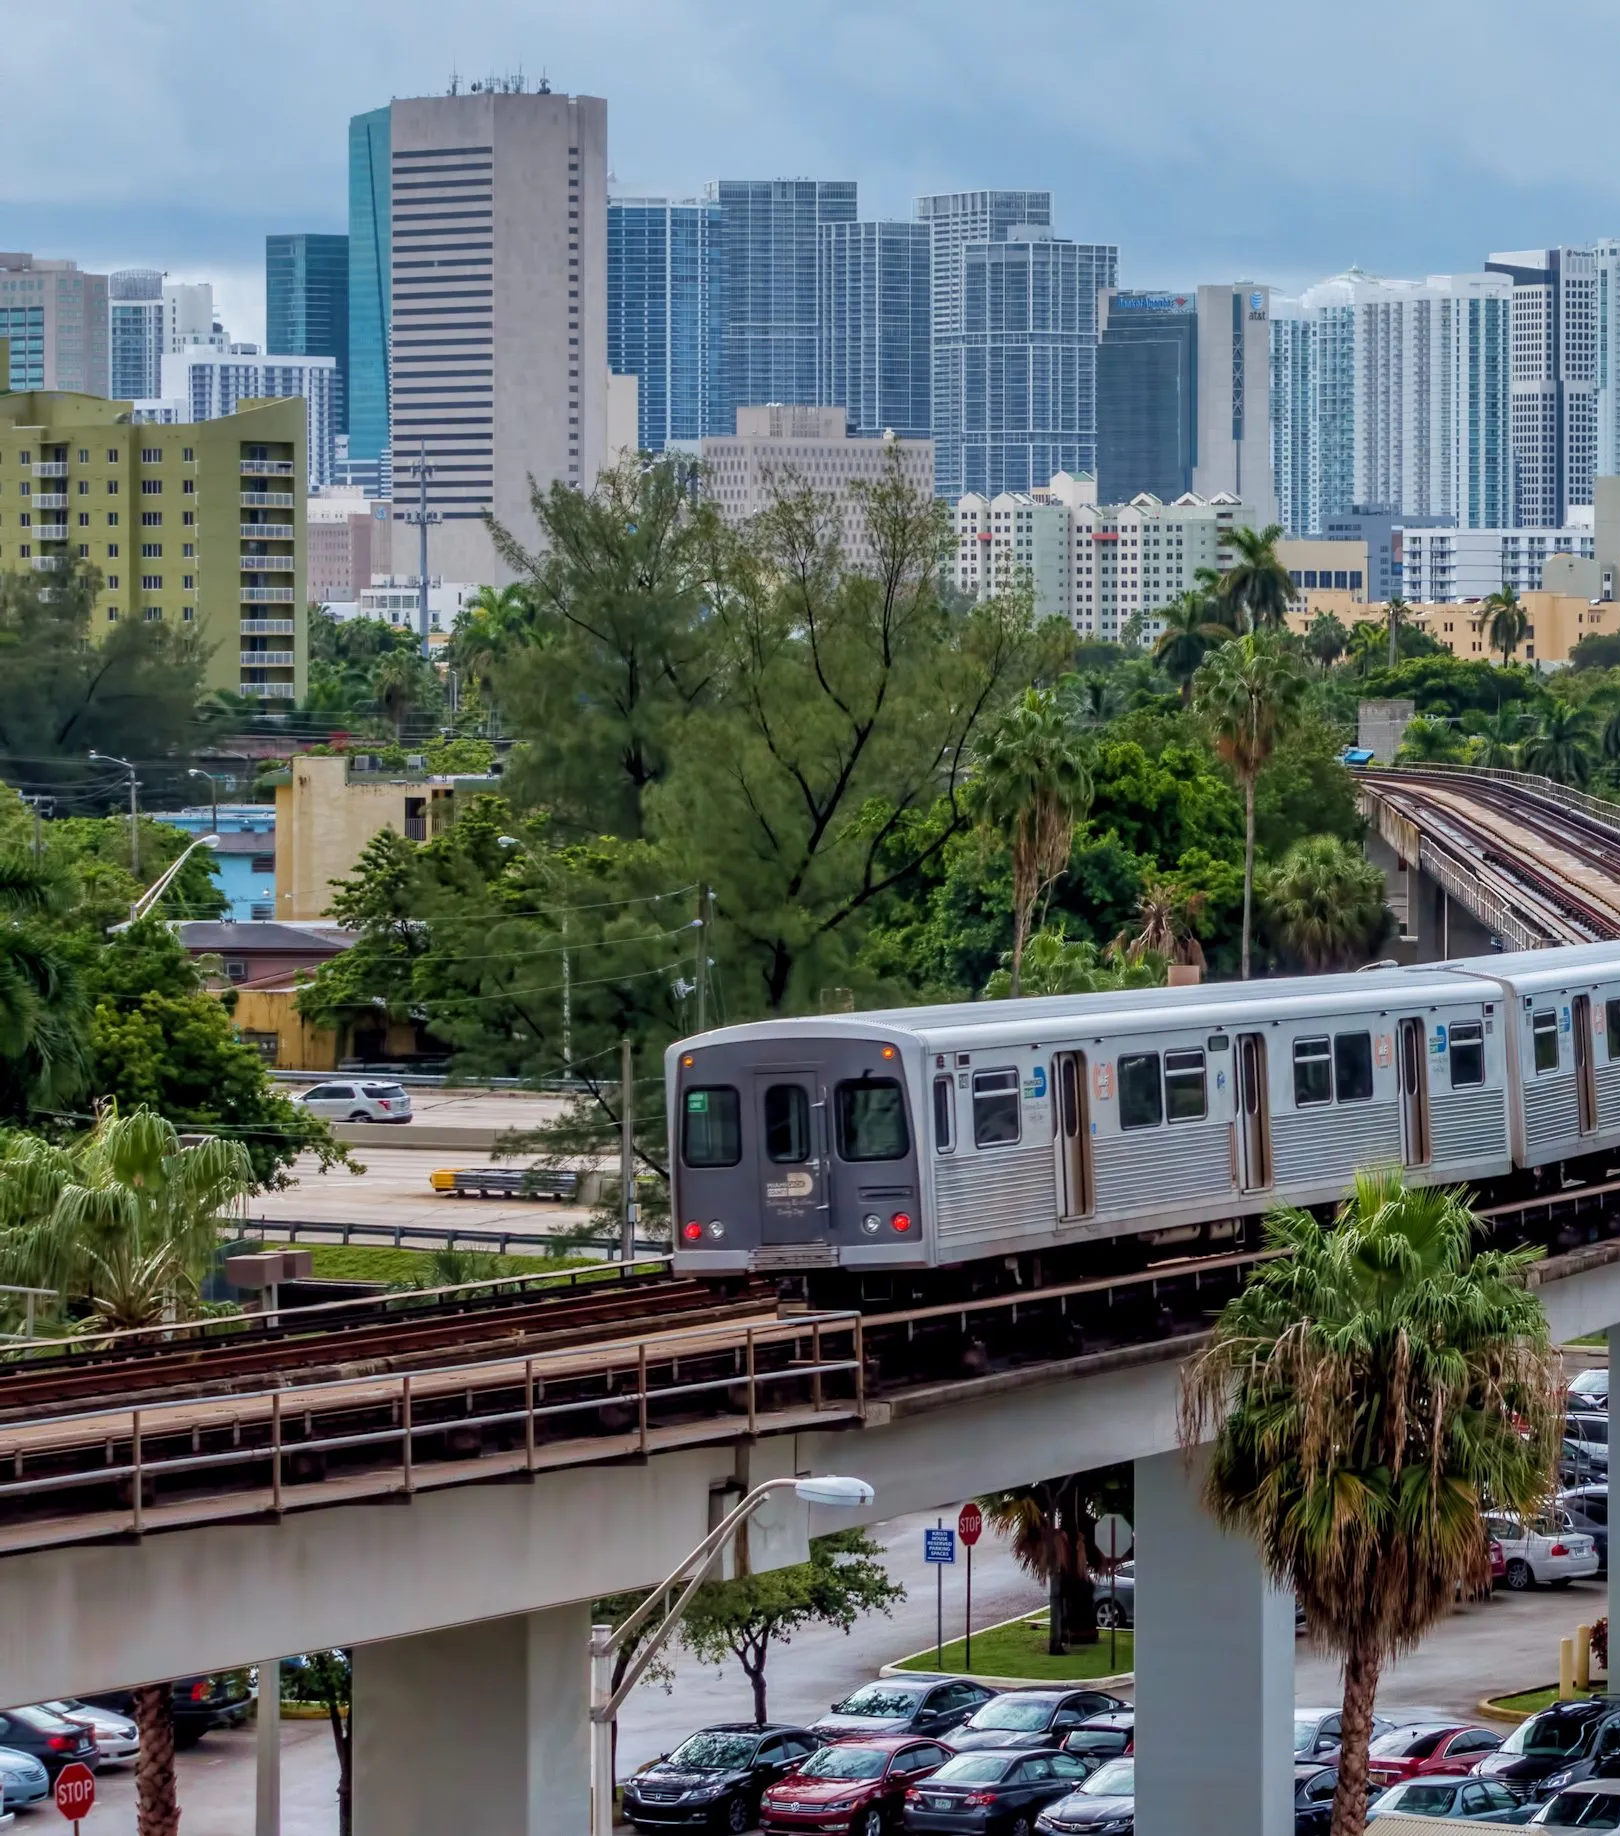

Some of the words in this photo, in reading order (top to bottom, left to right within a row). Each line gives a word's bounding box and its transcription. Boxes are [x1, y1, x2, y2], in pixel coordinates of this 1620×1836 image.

[1248, 310, 1266, 321] at&t
[959, 1515, 981, 1534] STOP
[58, 1779, 93, 1806] STOP
